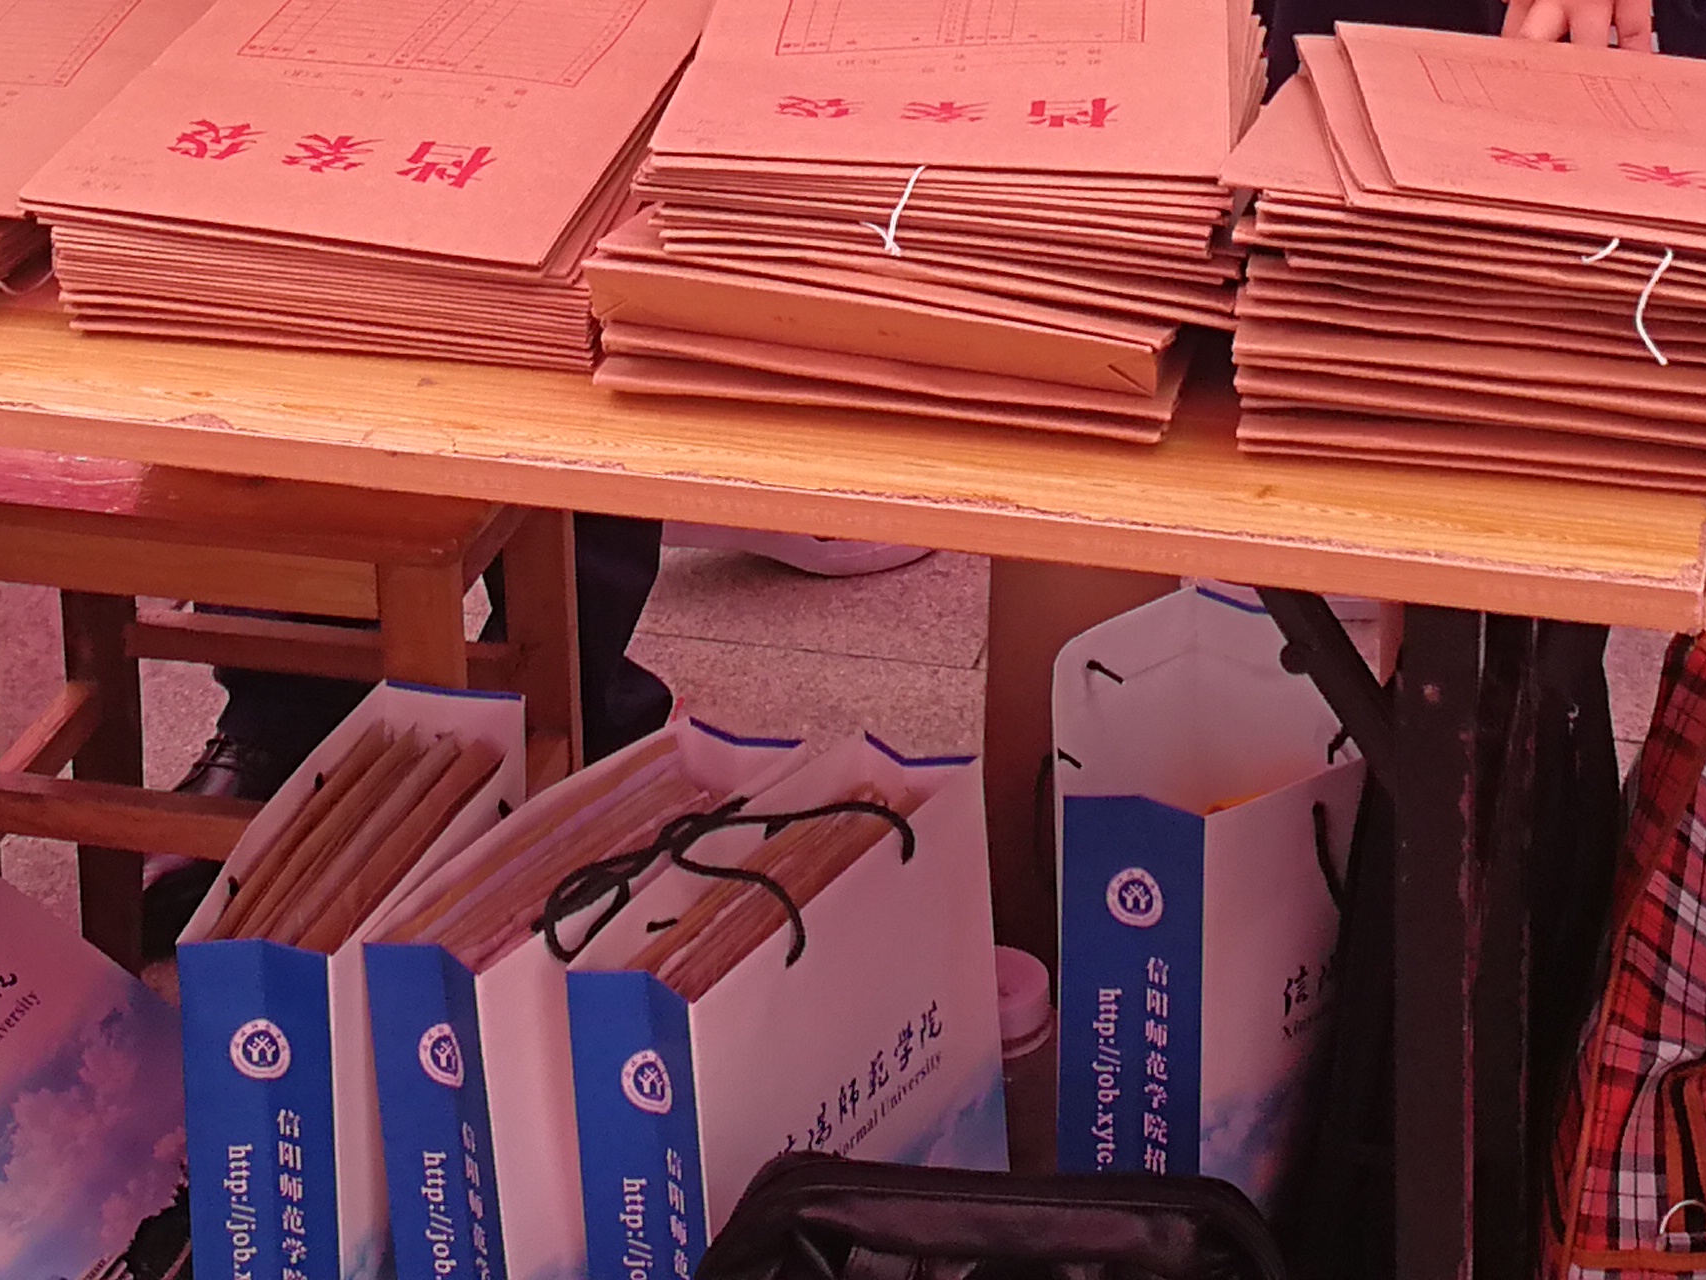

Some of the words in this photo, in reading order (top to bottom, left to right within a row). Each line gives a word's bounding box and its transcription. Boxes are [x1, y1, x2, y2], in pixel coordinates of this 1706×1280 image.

[772, 95, 1123, 132] 档案袋
[166, 119, 498, 189] 档案袋
